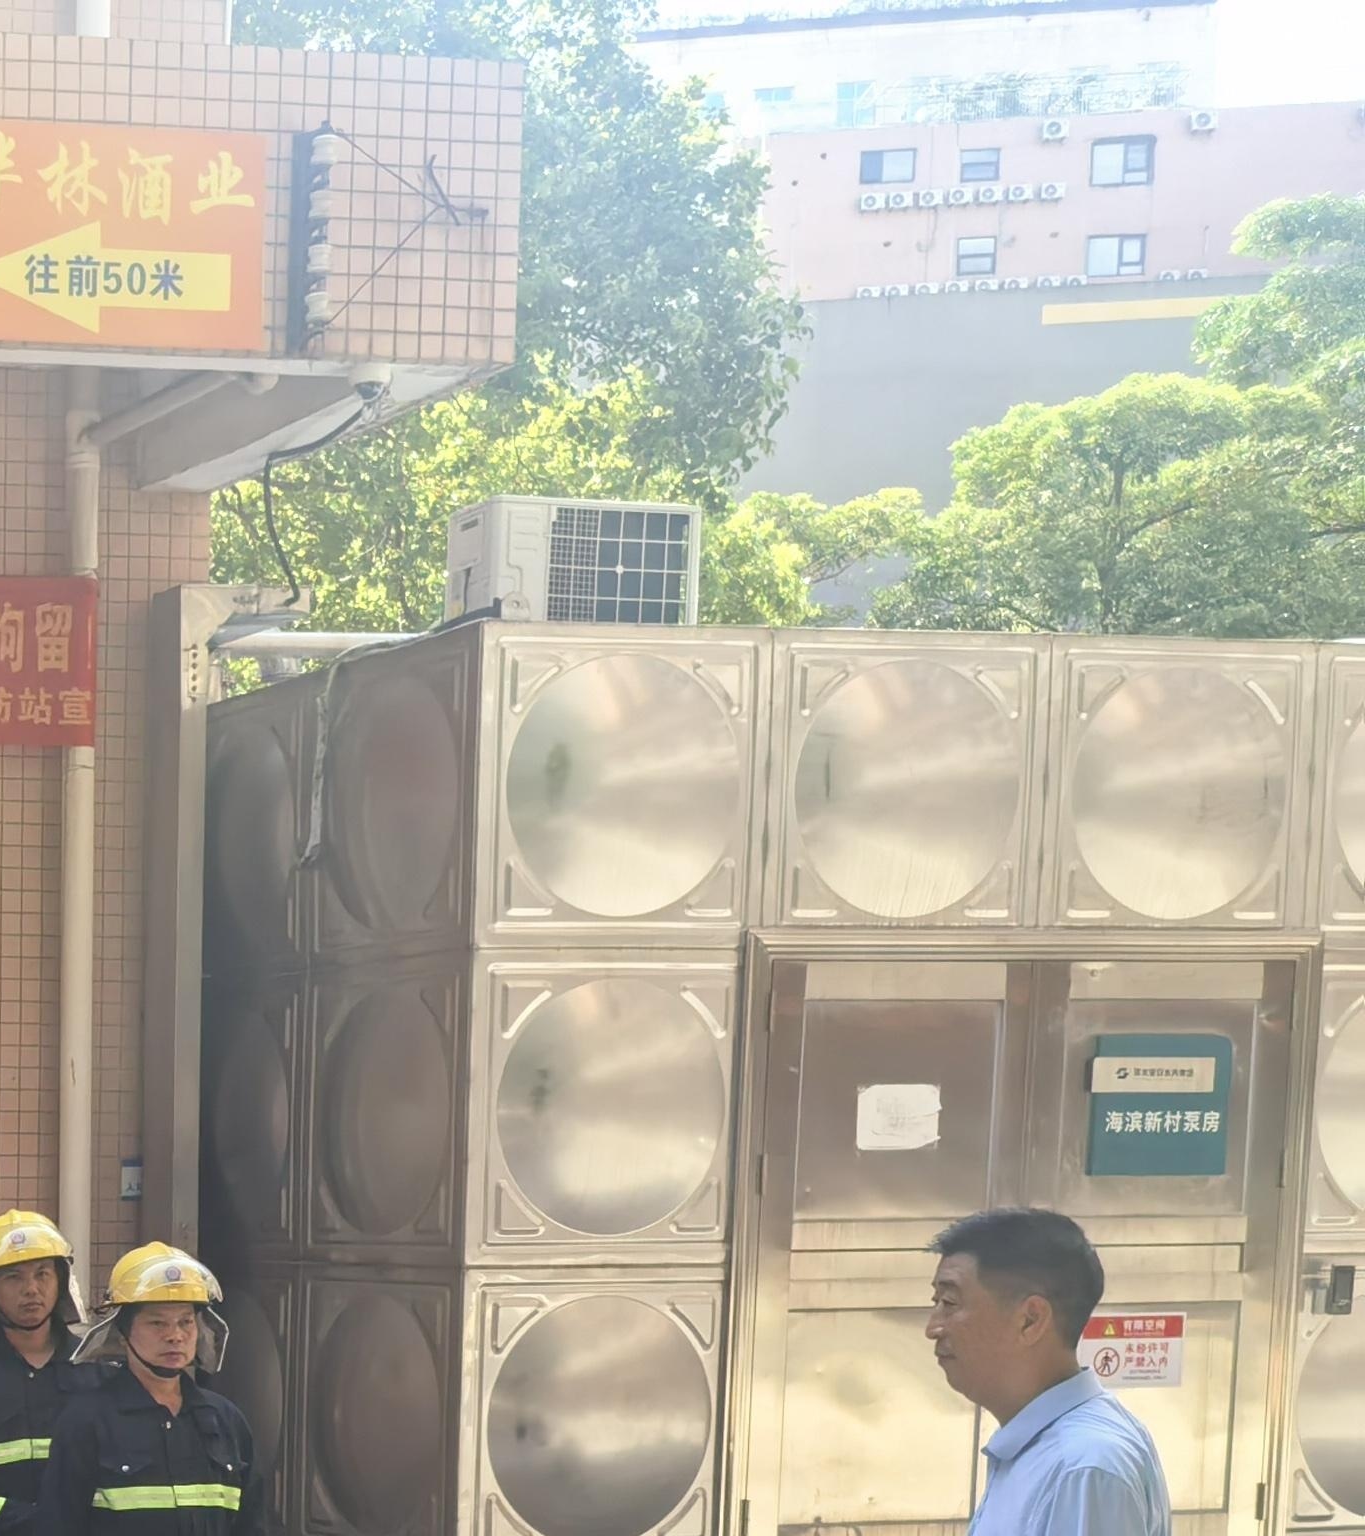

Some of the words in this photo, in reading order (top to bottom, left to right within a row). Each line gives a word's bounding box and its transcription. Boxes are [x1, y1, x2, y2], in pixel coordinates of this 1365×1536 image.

[24, 253, 184, 300] 往前50米
[1105, 1110, 1221, 1133] 海滨新村泵房
